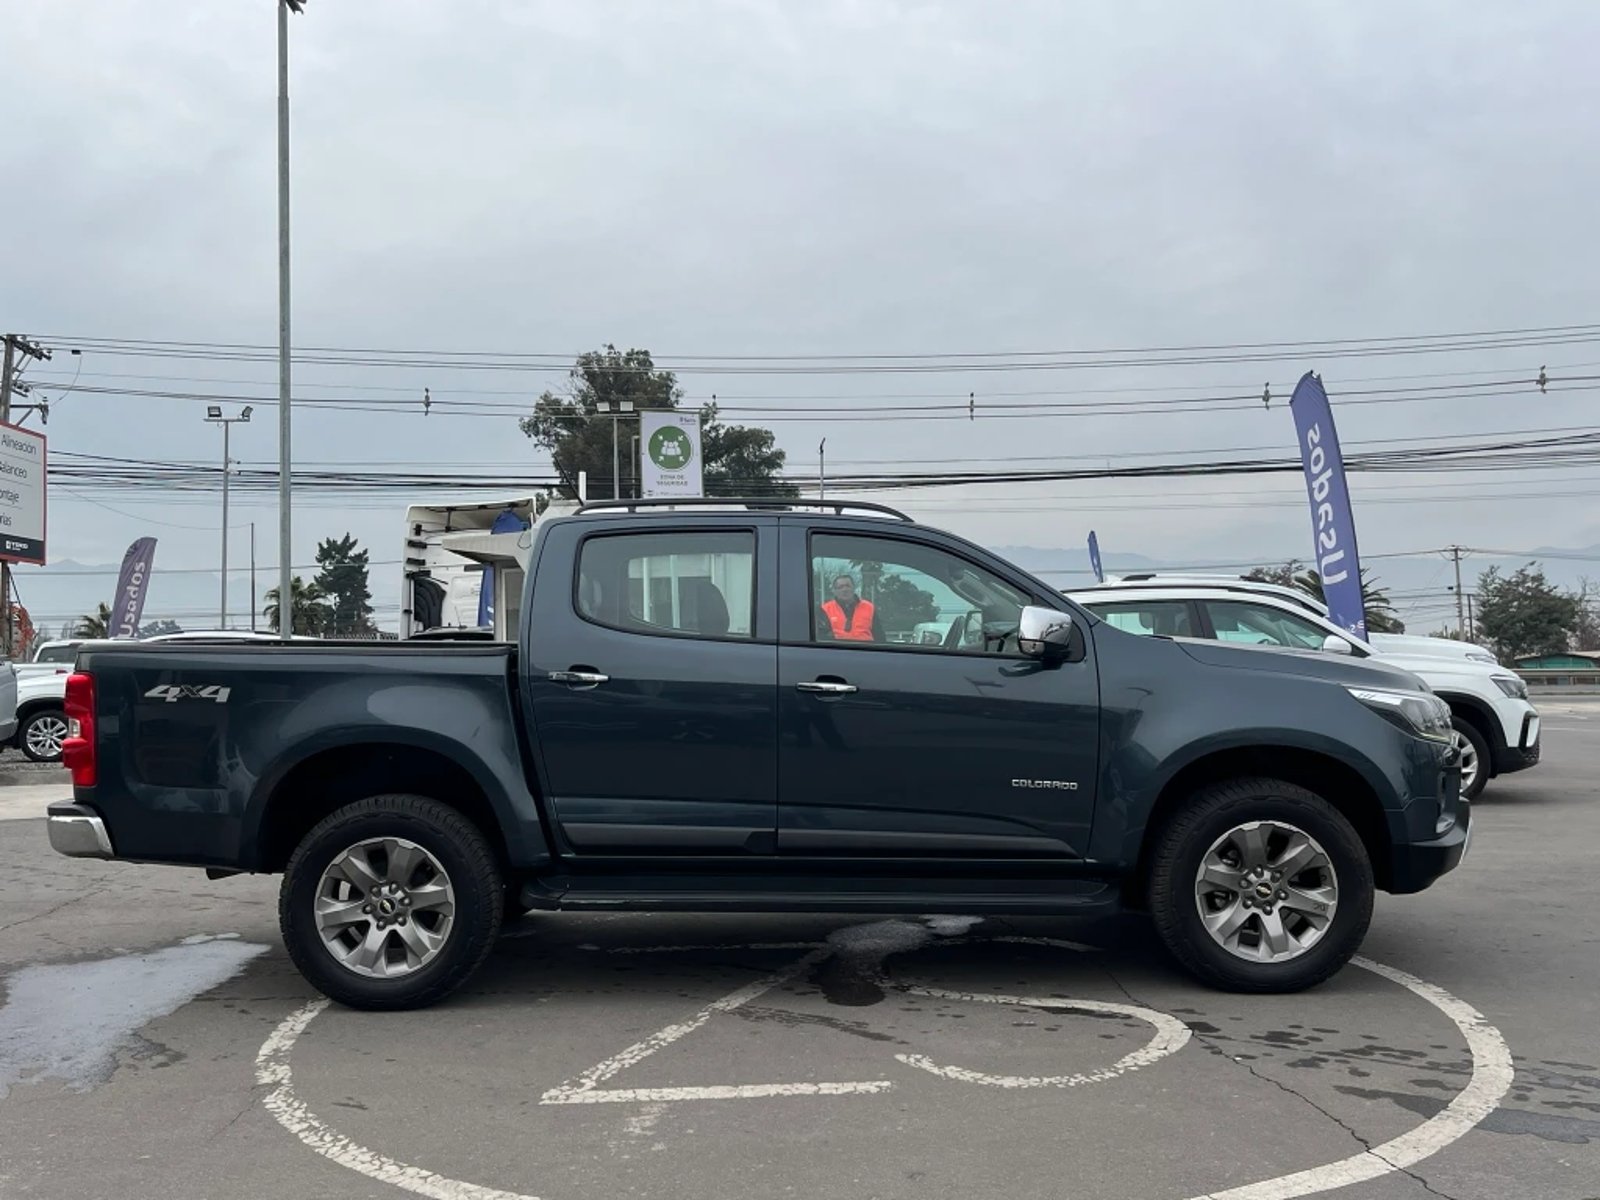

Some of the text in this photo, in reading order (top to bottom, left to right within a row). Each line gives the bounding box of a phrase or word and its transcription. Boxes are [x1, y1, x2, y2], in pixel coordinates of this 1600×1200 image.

[0, 460, 27, 478] alanceo
[119, 562, 146, 639] Usados
[1011, 779, 1078, 790] COLORADO
